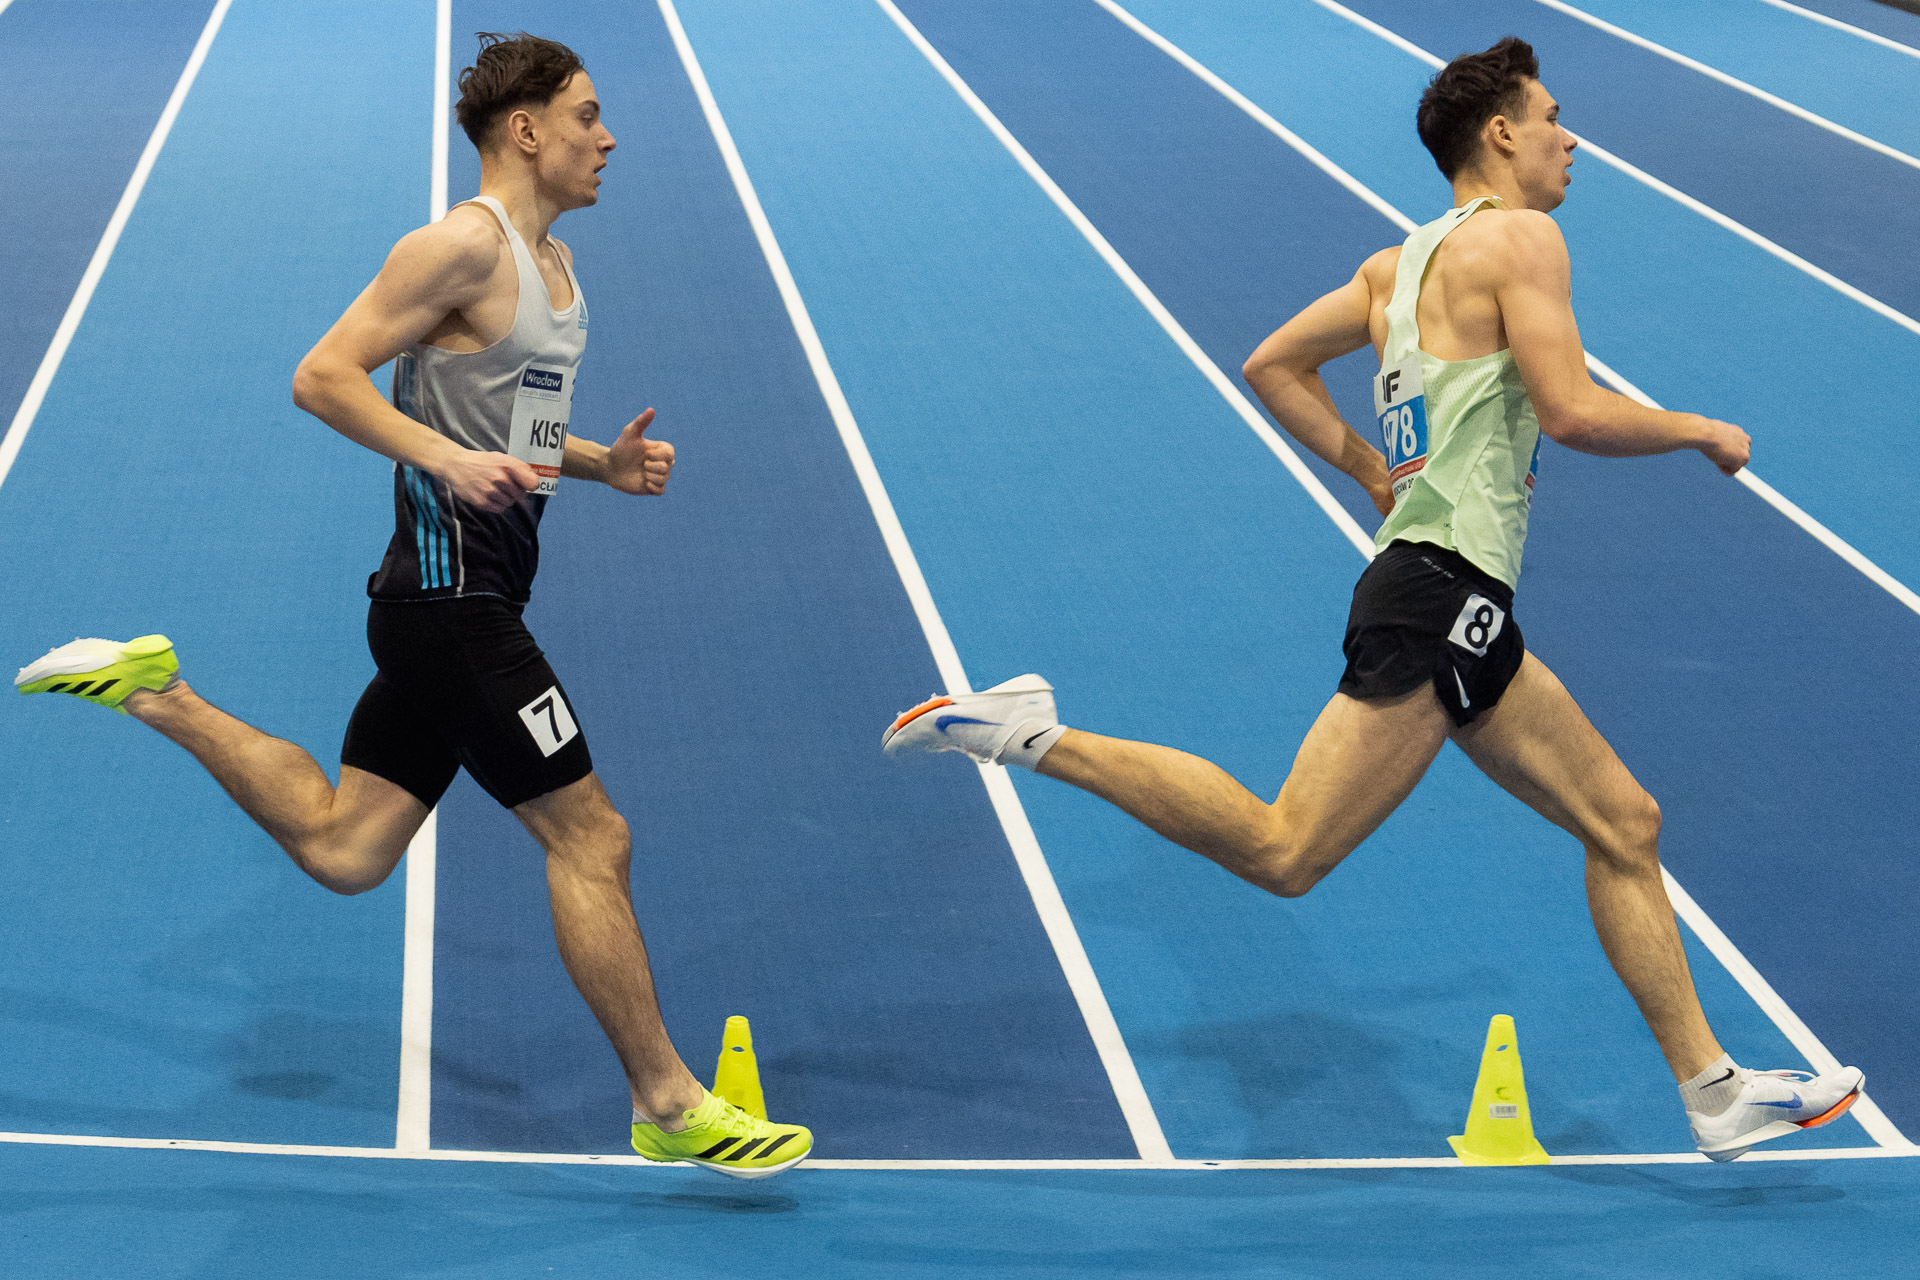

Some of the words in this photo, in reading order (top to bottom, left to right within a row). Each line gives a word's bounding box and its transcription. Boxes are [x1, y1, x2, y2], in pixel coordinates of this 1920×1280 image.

[530, 418, 569, 450] KISI
[1383, 404, 1418, 468] 978
[1465, 604, 1494, 649] 8
[530, 695, 563, 744] 7
